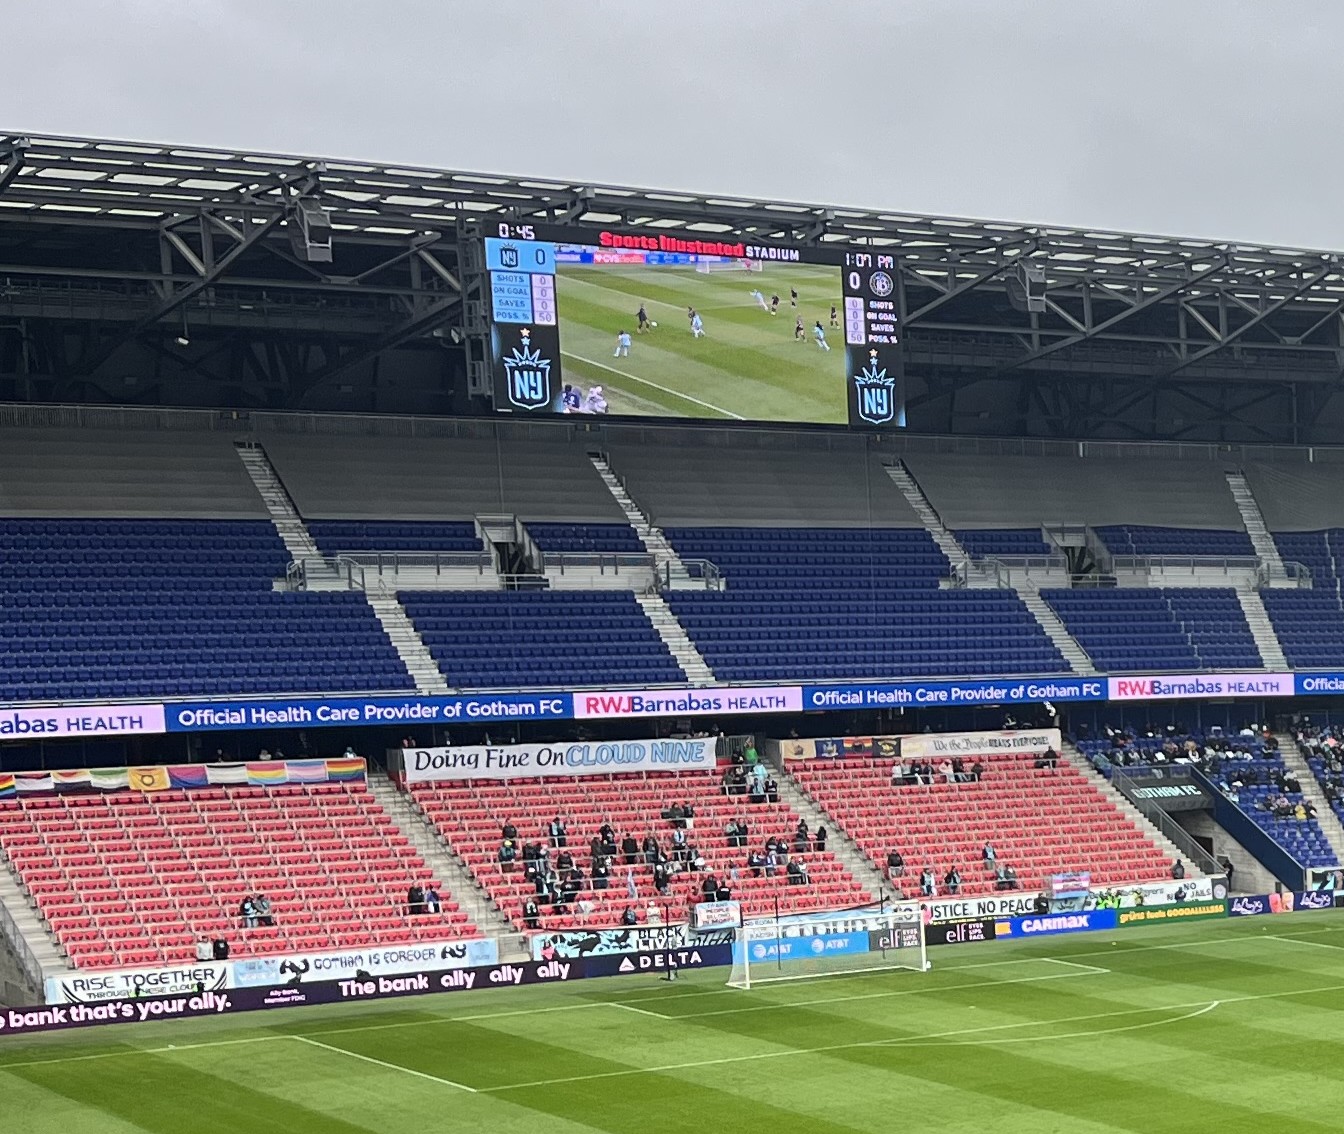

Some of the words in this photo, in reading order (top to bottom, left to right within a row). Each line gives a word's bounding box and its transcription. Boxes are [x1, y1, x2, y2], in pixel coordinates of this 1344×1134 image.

[498, 223, 536, 240] 0:45
[600, 231, 658, 250] Sports
[659, 234, 744, 257] Illustrated
[745, 246, 799, 261] STADIUM
[535, 248, 546, 265] 0
[846, 253, 872, 267] 1:07
[878, 255, 893, 270] PM
[850, 272, 860, 289] 0
[1118, 678, 1222, 696] RWJBarnabas
[1228, 681, 1279, 694] HEALTH
[178, 707, 246, 726] Official
[251, 704, 311, 723] Health
[317, 704, 359, 722] Care
[363, 701, 438, 721] Provider
[443, 700, 462, 717] of
[466, 698, 535, 717] Gotham
[540, 699, 563, 715] FC
[586, 694, 721, 714] RWJBarnabas
[728, 696, 786, 710] HEALTH
[66, 715, 143, 731] HEALTH
[415, 750, 479, 771] Doing
[486, 749, 530, 768] Fine
[537, 747, 564, 767] On
[566, 743, 646, 766] CLOUD
[651, 741, 705, 763] NINE
[1130, 786, 1185, 799] GOTHAM
[1181, 785, 1202, 795] FC
[1184, 882, 1196, 891] NO
[977, 902, 996, 915] NO
[946, 924, 966, 942] elf
[825, 938, 849, 949] AT&T
[383, 949, 436, 965] FOREVER
[639, 951, 702, 968] DELTA
[73, 975, 115, 992] RISE
[121, 968, 216, 988] TOGETHER
[339, 980, 375, 997] The
[379, 975, 429, 994] bank
[440, 969, 476, 989] ally
[489, 965, 524, 984] ally
[537, 961, 570, 980] ally
[8, 1007, 68, 1028] bank
[70, 1001, 133, 1022] that's
[134, 1000, 186, 1021] your
[188, 993, 232, 1017] ally.
